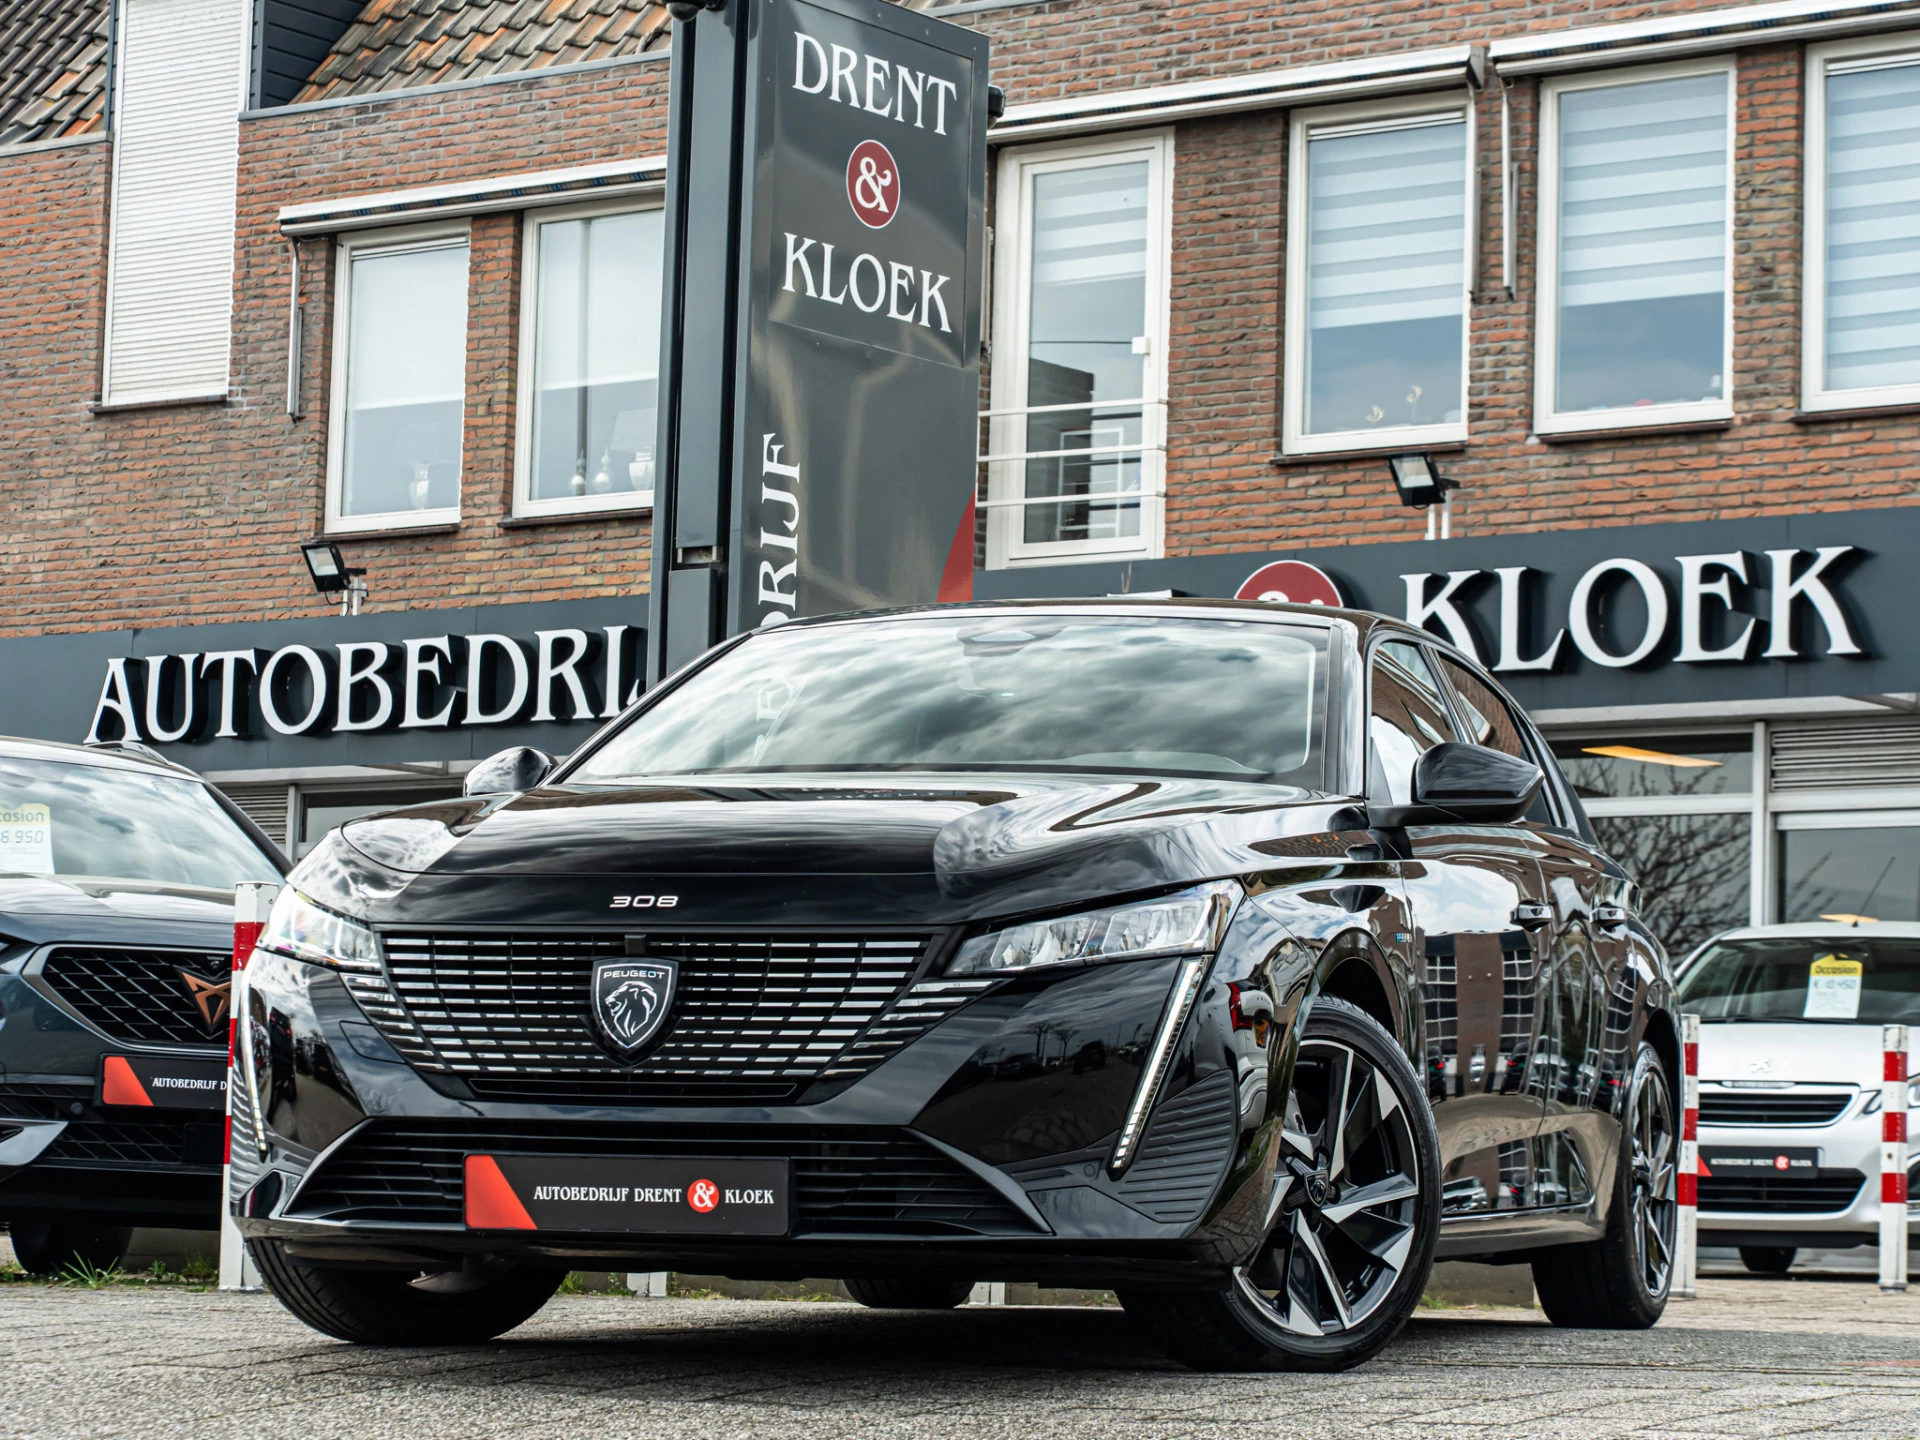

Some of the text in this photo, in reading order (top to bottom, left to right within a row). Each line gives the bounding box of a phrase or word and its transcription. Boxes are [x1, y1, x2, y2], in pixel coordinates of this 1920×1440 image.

[792, 31, 957, 136] DRENT
[854, 156, 892, 213] &
[782, 232, 952, 333] KLOEK
[1399, 545, 1863, 672] KLOEK
[0, 810, 44, 822] asion
[609, 895, 679, 908] 308
[603, 970, 666, 979] PEUGEOT
[152, 1077, 218, 1090] AUTOBEDRIJF
[533, 1182, 775, 1208] AUTOBEDRIJF DRENT & KLOEK
